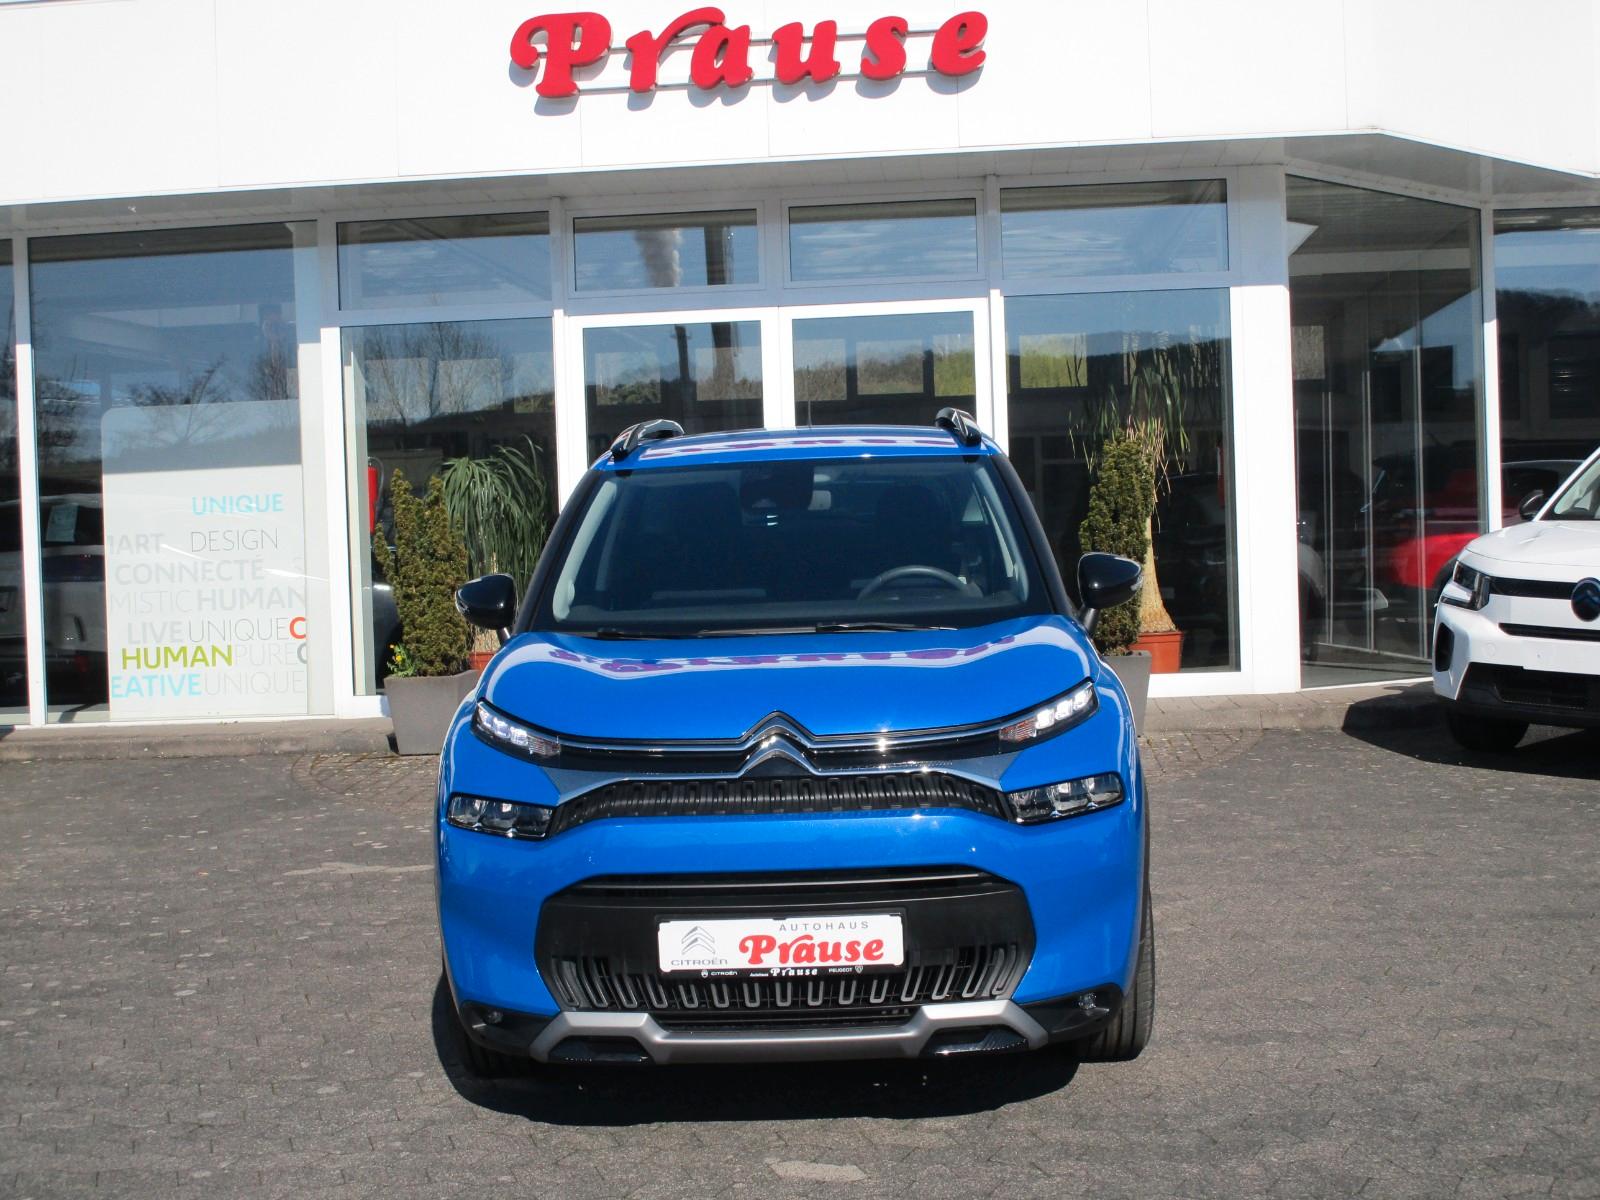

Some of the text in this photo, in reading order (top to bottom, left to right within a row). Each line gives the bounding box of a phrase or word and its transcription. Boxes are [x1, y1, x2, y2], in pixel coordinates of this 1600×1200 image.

[509, 6, 989, 98] Prause
[192, 493, 284, 515] UNIQUE
[190, 528, 279, 553] DESIGN
[115, 554, 265, 586] CONNECTÉ
[198, 586, 306, 612] HUMAN
[127, 621, 183, 645] LIVE
[188, 617, 289, 643] UNIQUE
[121, 644, 233, 670] HUMAN
[235, 642, 297, 667] PURE
[111, 671, 305, 699] EATIVE UNIQUE
[779, 920, 869, 932] AUTOHAUS
[738, 934, 884, 965] Prause
[770, 967, 818, 977] Prause
